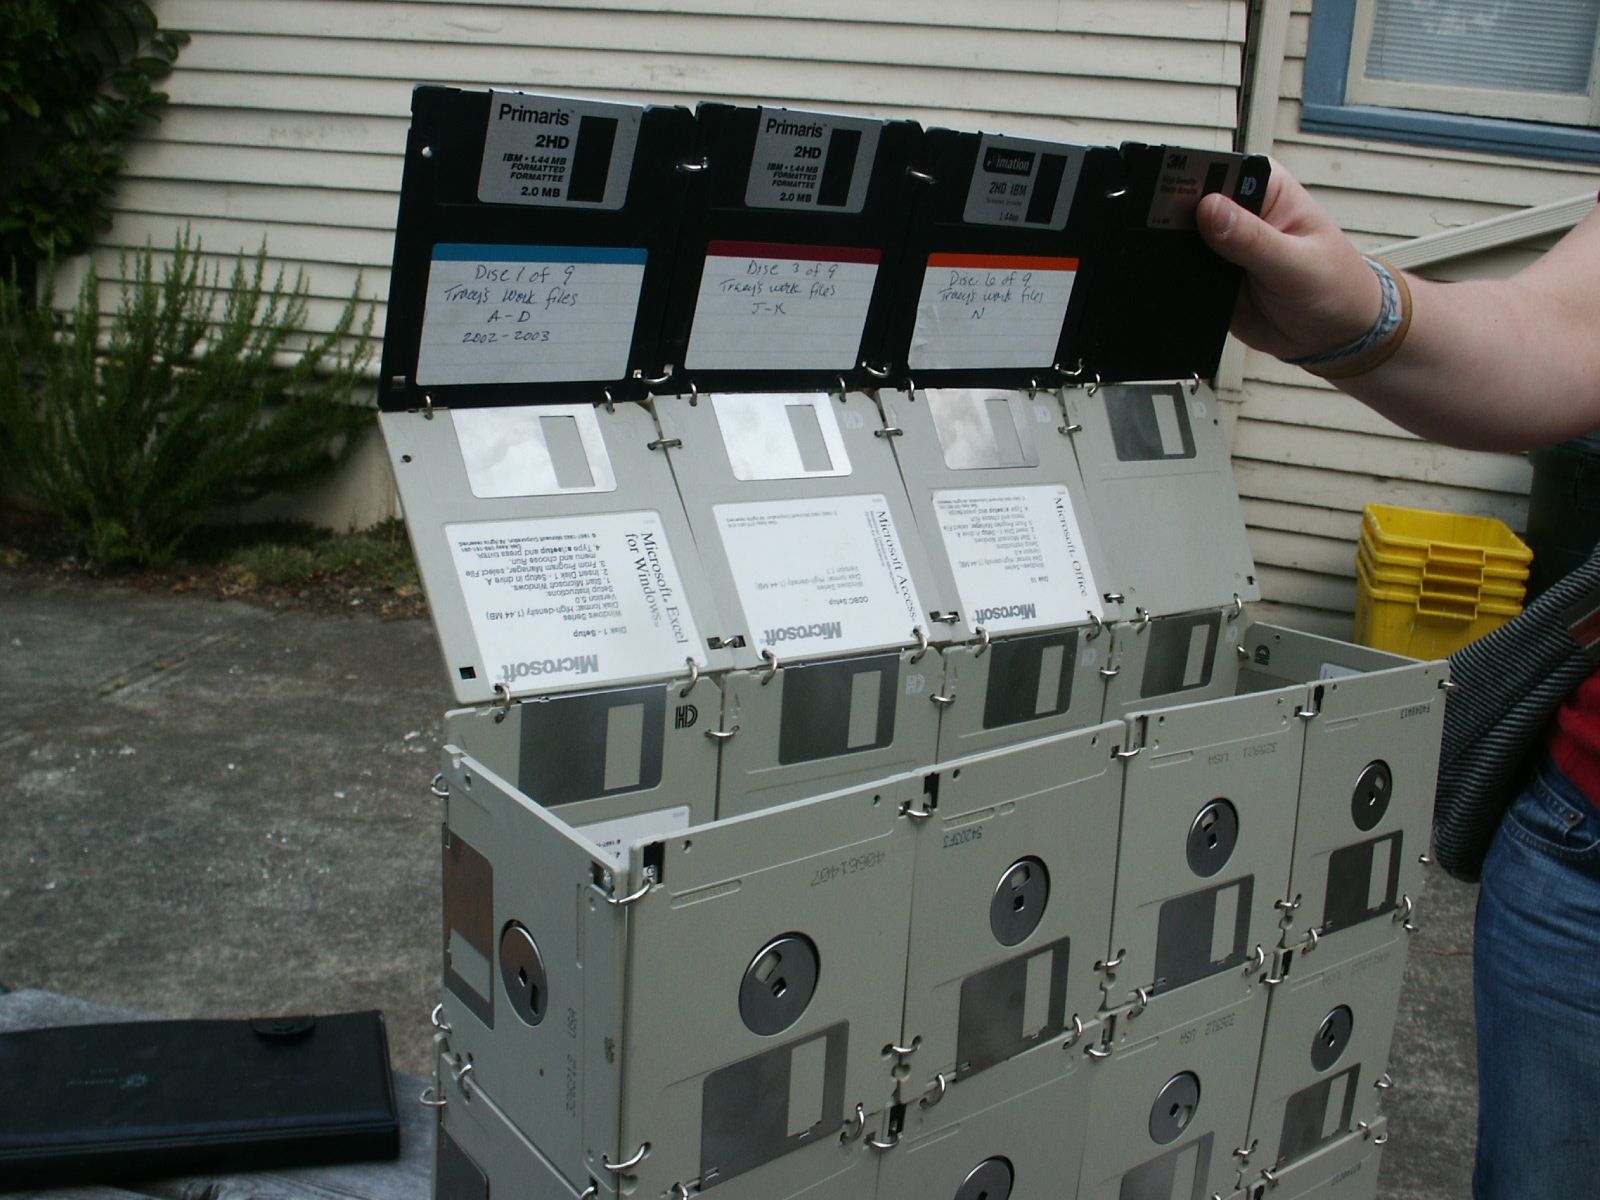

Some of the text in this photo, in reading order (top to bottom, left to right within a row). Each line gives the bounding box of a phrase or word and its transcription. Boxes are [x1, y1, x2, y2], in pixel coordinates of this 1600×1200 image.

[499, 104, 570, 126] Primaris
[766, 119, 823, 138] Primaris
[535, 134, 569, 149] 2HD
[502, 153, 567, 165] IBM 1.44 MB
[794, 146, 821, 159] 2HD
[511, 163, 566, 173] FORMATTED
[806, 166, 818, 174] MB
[773, 172, 817, 181] FORMATTED
[520, 187, 560, 197] 2.0 MB
[989, 181, 1027, 196] 2HD IBM
[780, 192, 811, 202] 2.0 MB
[475, 264, 576, 285] Disc 1 of 9
[746, 259, 838, 279] Disc 3 of 9
[949, 270, 1032, 286] Disc 6 of 9
[545, 286, 579, 310] files
[810, 282, 836, 299] files
[971, 307, 985, 319] N
[624, 533, 642, 553] for
[876, 511, 903, 569] Microsoft
[464, 570, 479, 578] File
[494, 575, 514, 585] drive
[515, 575, 523, 583] in
[524, 572, 546, 582] Setup
[1071, 560, 1089, 596] Office
[974, 602, 1037, 624] Microsoft
[665, 606, 688, 643] Excel
[572, 627, 596, 638] Setup
[763, 620, 843, 647] Microsoft
[501, 653, 600, 683] Microsoft
[675, 704, 699, 729] HD
